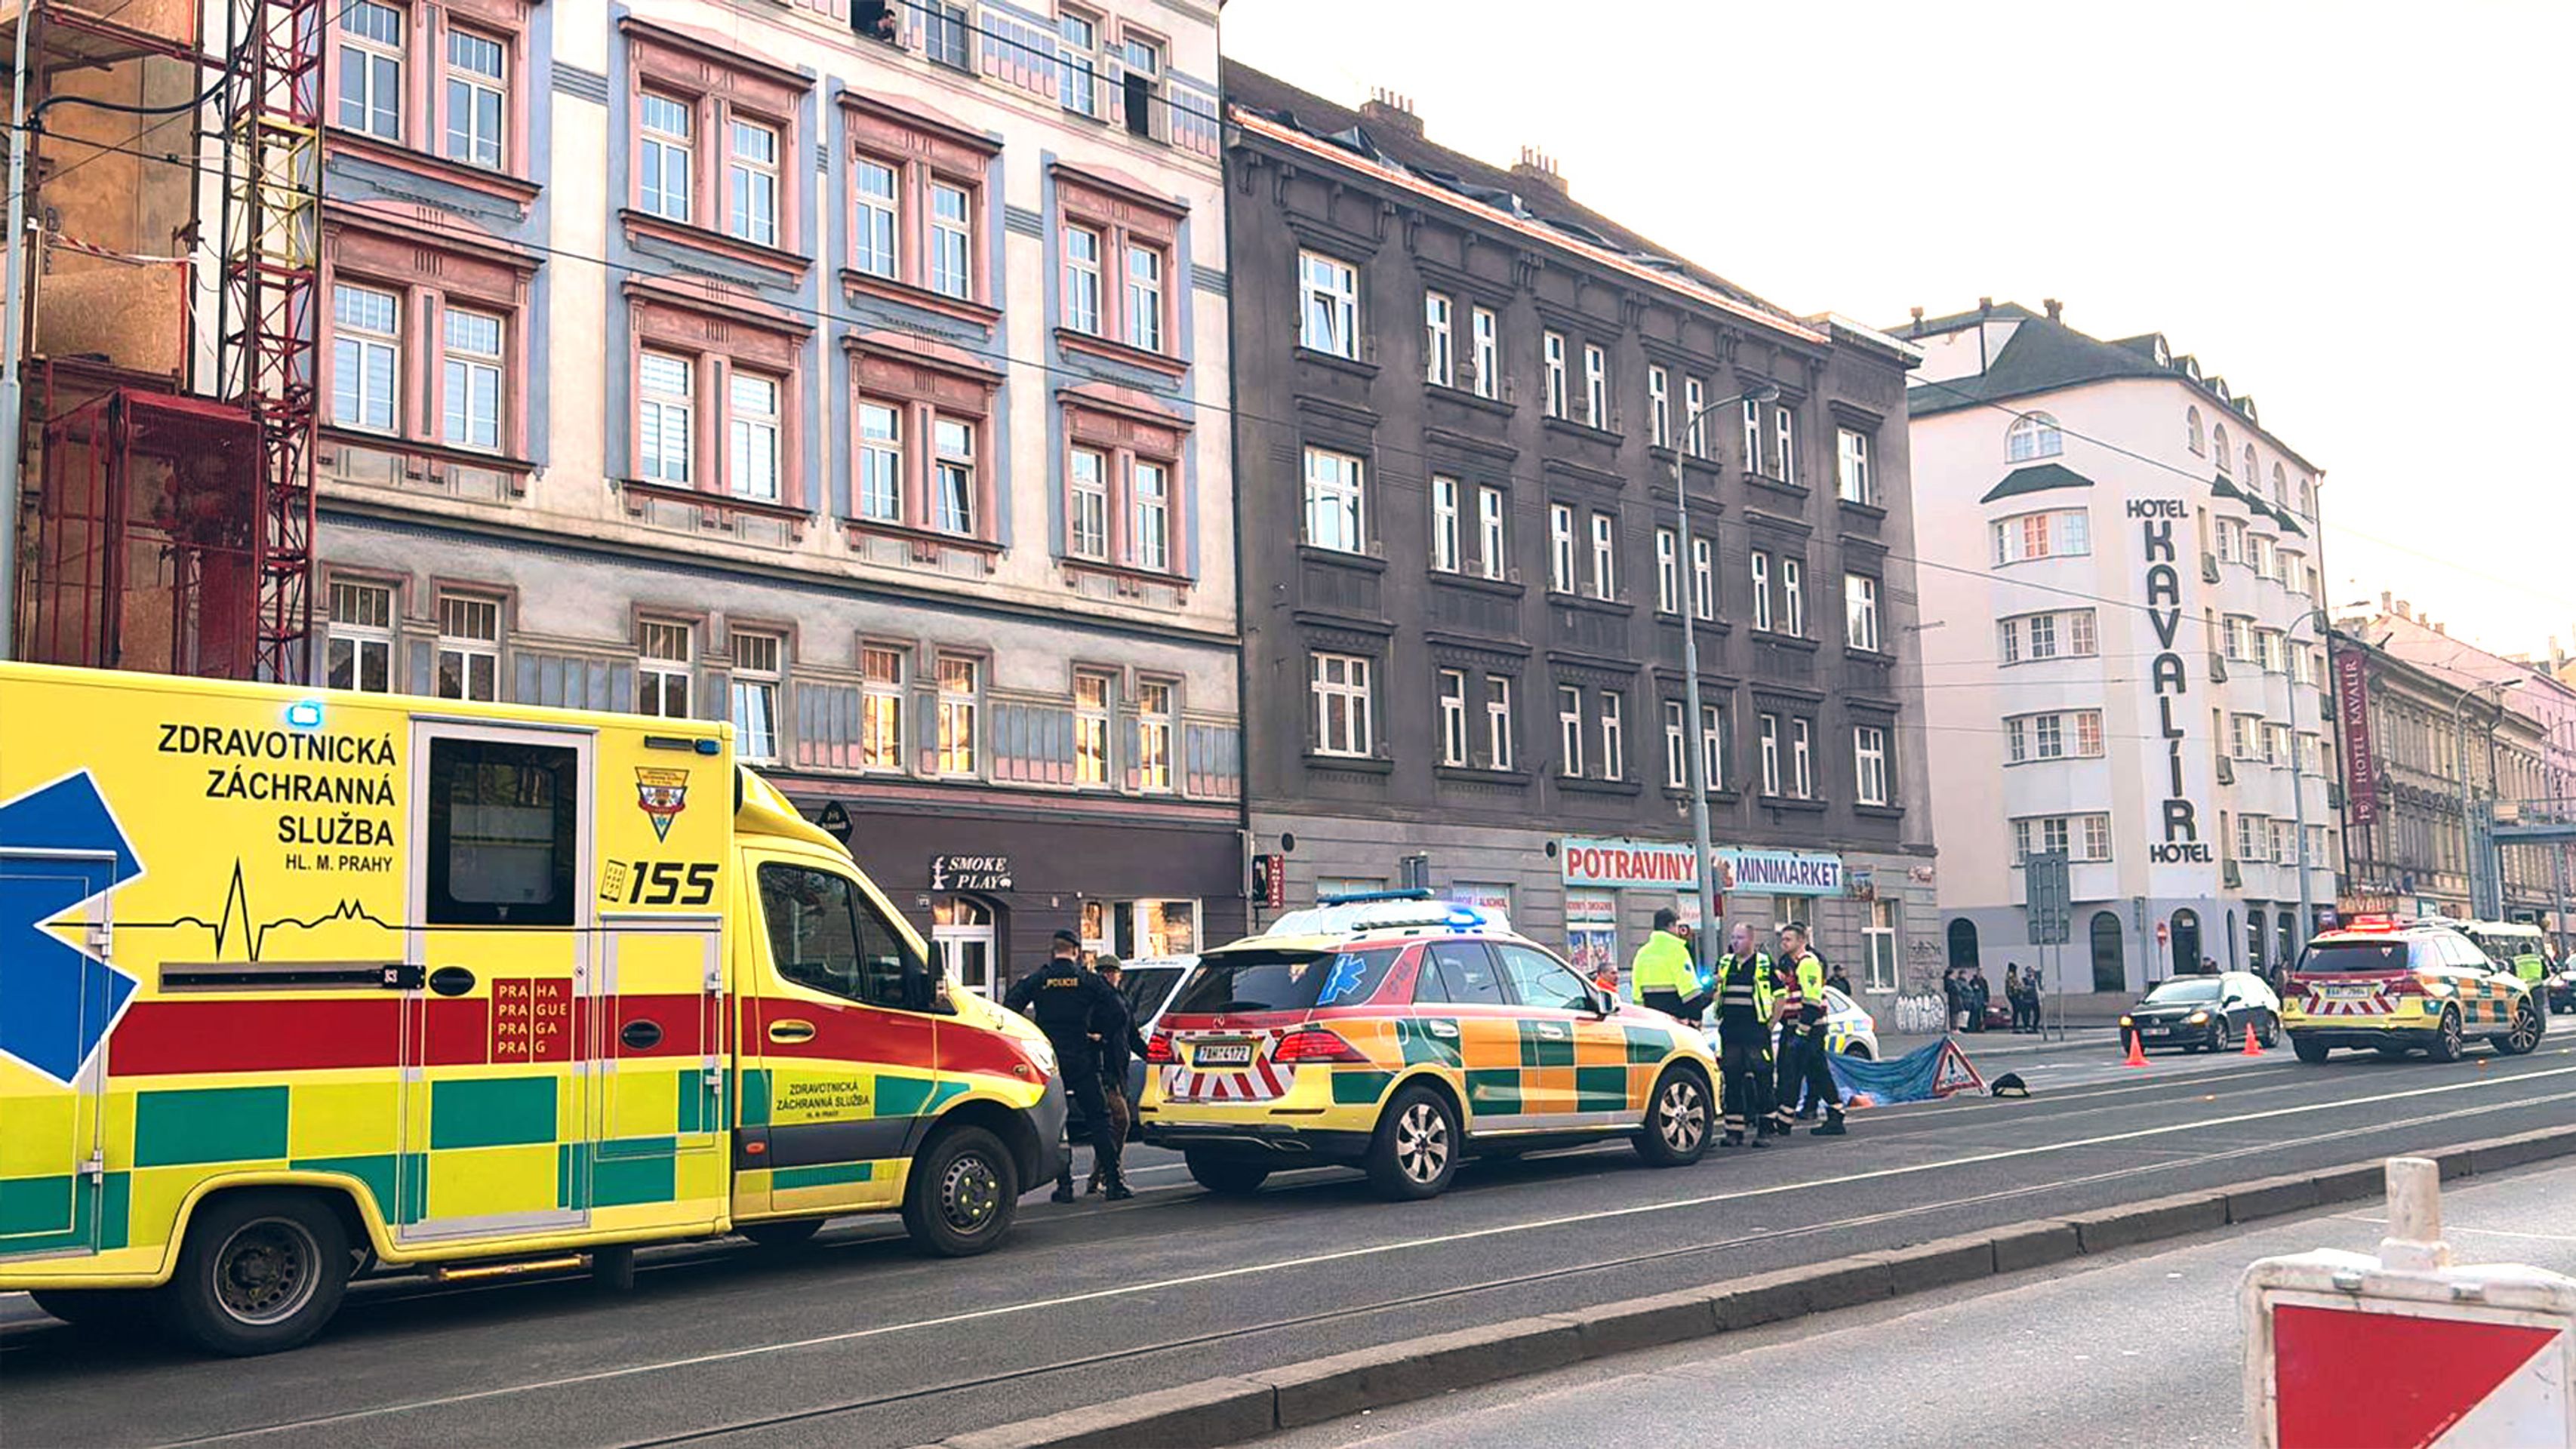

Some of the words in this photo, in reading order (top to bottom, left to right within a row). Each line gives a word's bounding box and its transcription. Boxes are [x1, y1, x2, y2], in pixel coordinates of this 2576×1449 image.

[2126, 499, 2189, 518] HOTEL
[2144, 520, 2196, 841] KAVALÍR
[158, 724, 396, 766] ZDRAVOTNICKÁ
[2353, 737, 2368, 783] HOTEL
[206, 764, 395, 806] ZÁCHRANNÁ
[279, 811, 394, 846] SLUŽBA
[286, 854, 311, 870] HL.
[316, 854, 333, 870] M.
[339, 855, 392, 872] PRAHY
[949, 856, 1007, 872] SMOKE
[2150, 844, 2213, 863] HOTEL
[1567, 848, 1695, 881] POTRAVINY
[1737, 857, 1839, 887] MINIMARKET
[629, 862, 719, 905] 155
[956, 874, 999, 890] PLAY
[789, 1078, 858, 1095] ZDRAVOTNICKÁ
[777, 1097, 833, 1110] ZÁCHRANNÁ
[835, 1094, 869, 1107] SLUŽBA
